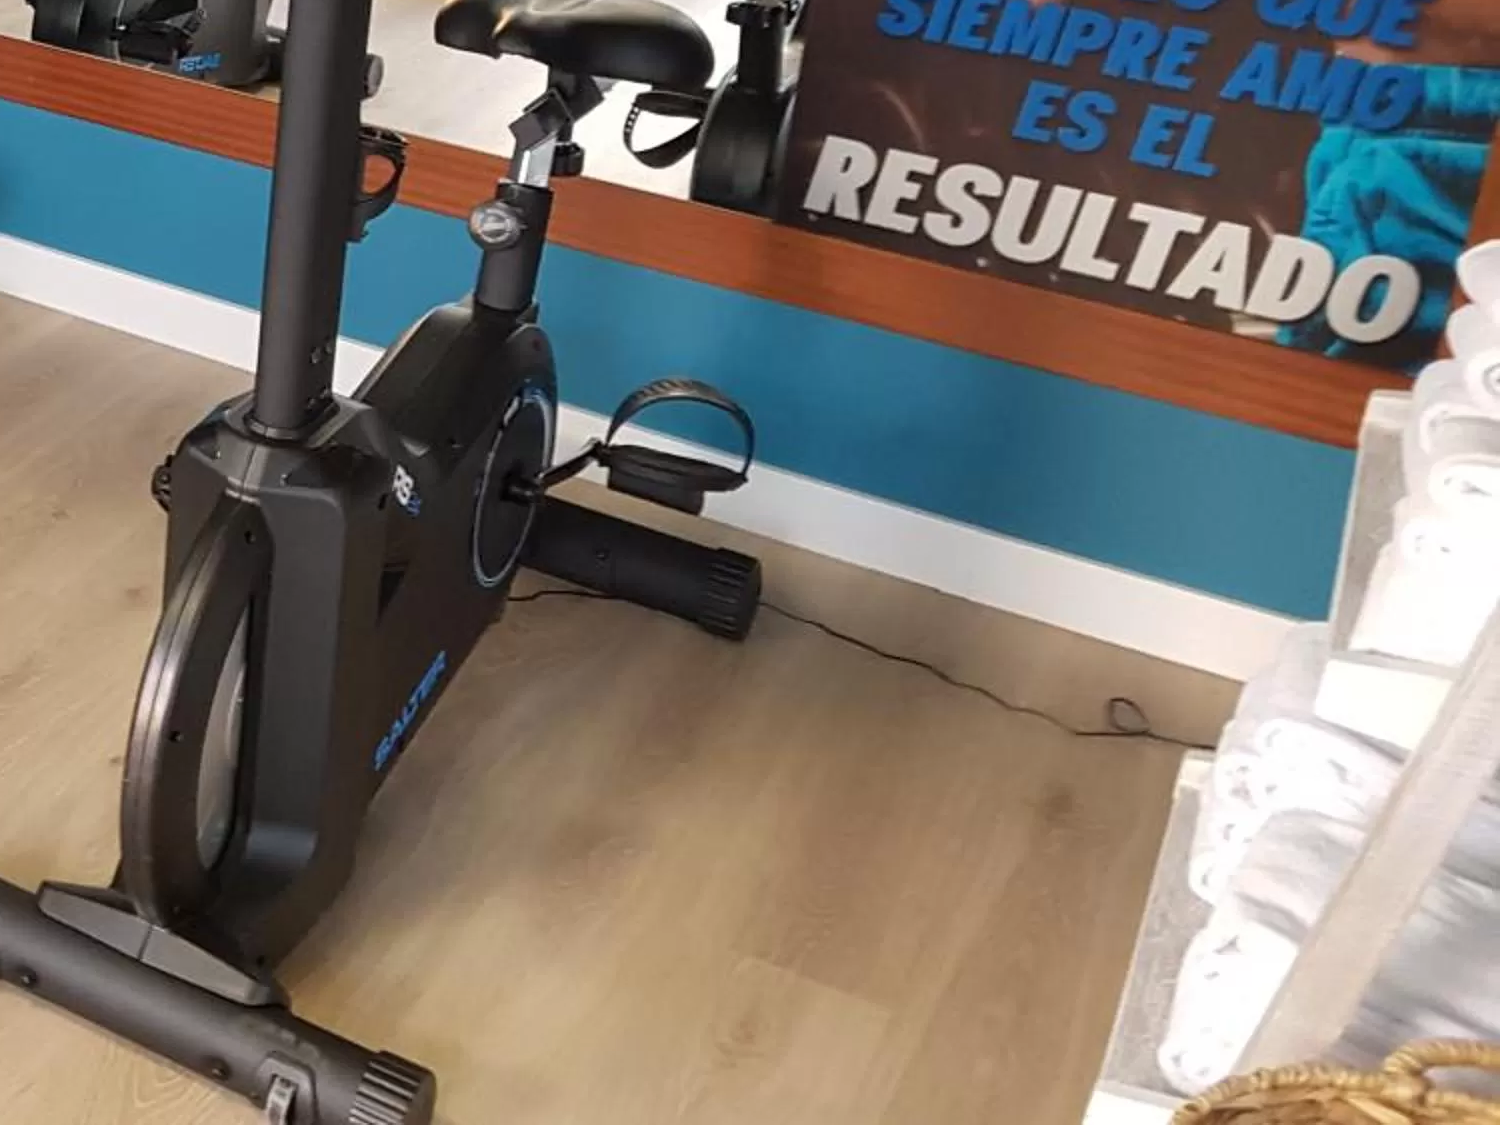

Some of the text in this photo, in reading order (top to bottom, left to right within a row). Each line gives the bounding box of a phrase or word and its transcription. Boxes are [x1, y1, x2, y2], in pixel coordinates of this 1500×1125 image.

[1011, 82, 1218, 179] ES EL
[1218, 42, 1424, 132] AMO
[803, 134, 1421, 344] RESULTADO
